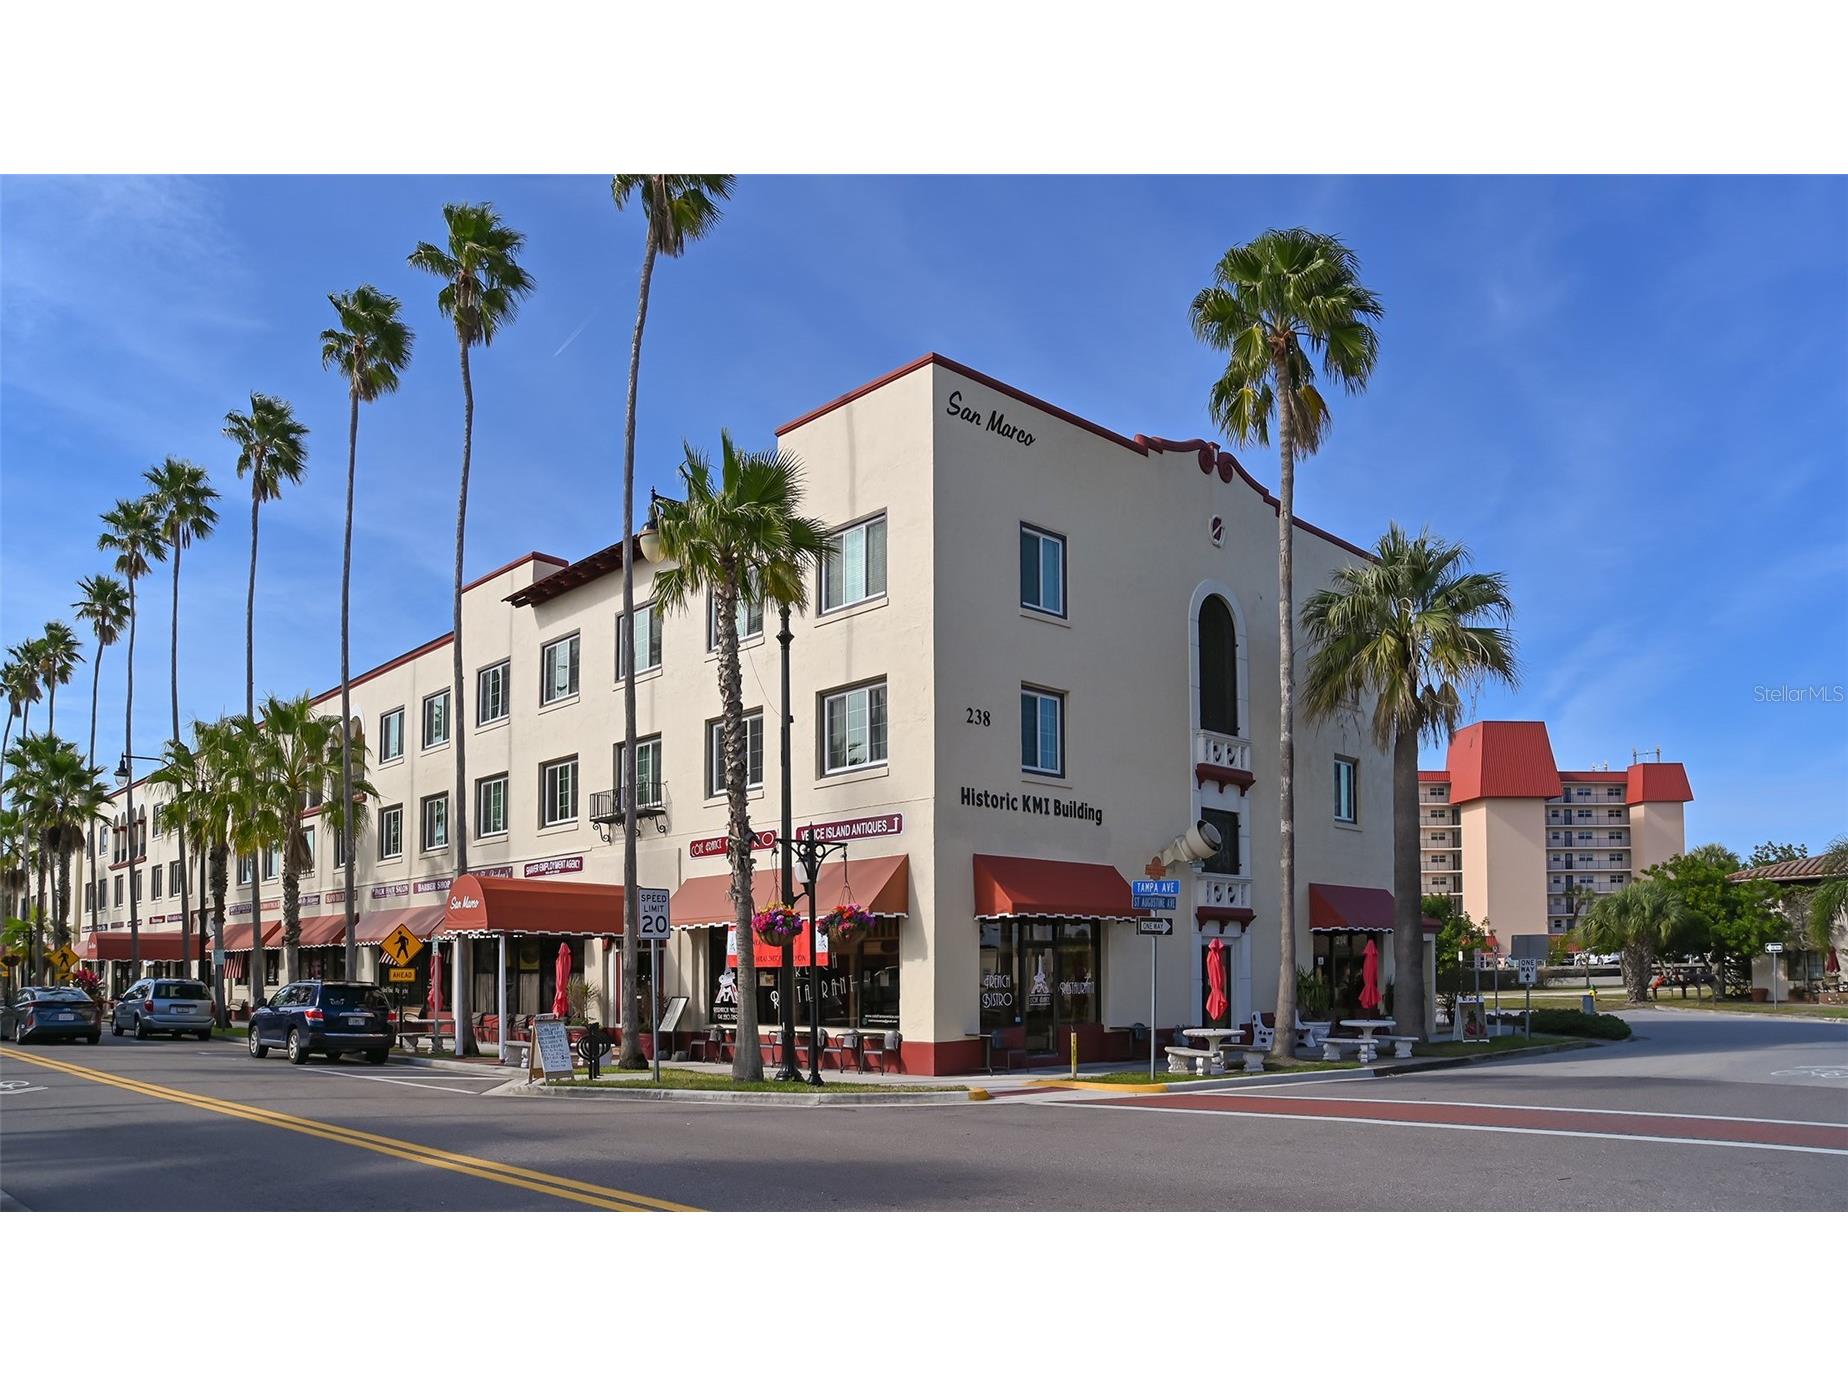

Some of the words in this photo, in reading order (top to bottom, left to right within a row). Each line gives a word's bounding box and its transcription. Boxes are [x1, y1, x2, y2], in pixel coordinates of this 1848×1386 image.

[947, 390, 981, 426] San
[985, 410, 1036, 446] Marco
[966, 707, 991, 727] 238
[960, 786, 1018, 811] Historic
[1022, 794, 1050, 815] KMI
[1053, 799, 1103, 826] Building
[801, 827, 825, 841] VEICE
[825, 825, 851, 839] ISLAND
[851, 820, 887, 836] ANTIQUES
[539, 860, 566, 872] EMPLOYMENT
[566, 859, 580, 869] AGENCY
[417, 881, 436, 892] BARBER
[437, 879, 450, 890] SHOP
[1137, 882, 1159, 893] TAMPA
[1161, 882, 1175, 893] AVE
[450, 896, 462, 910] San
[641, 894, 667, 903] SPEED
[1134, 896, 1140, 907] ST
[1142, 896, 1165, 908] AUGUSTINE
[1167, 898, 1175, 908] AVE
[643, 905, 664, 913] LIMIT
[642, 915, 667, 933] 20
[1143, 922, 1153, 930] ONE
[393, 971, 412, 979] AHEAD
[984, 974, 1011, 989] FRENCH
[982, 992, 1013, 1009] BISTRO
